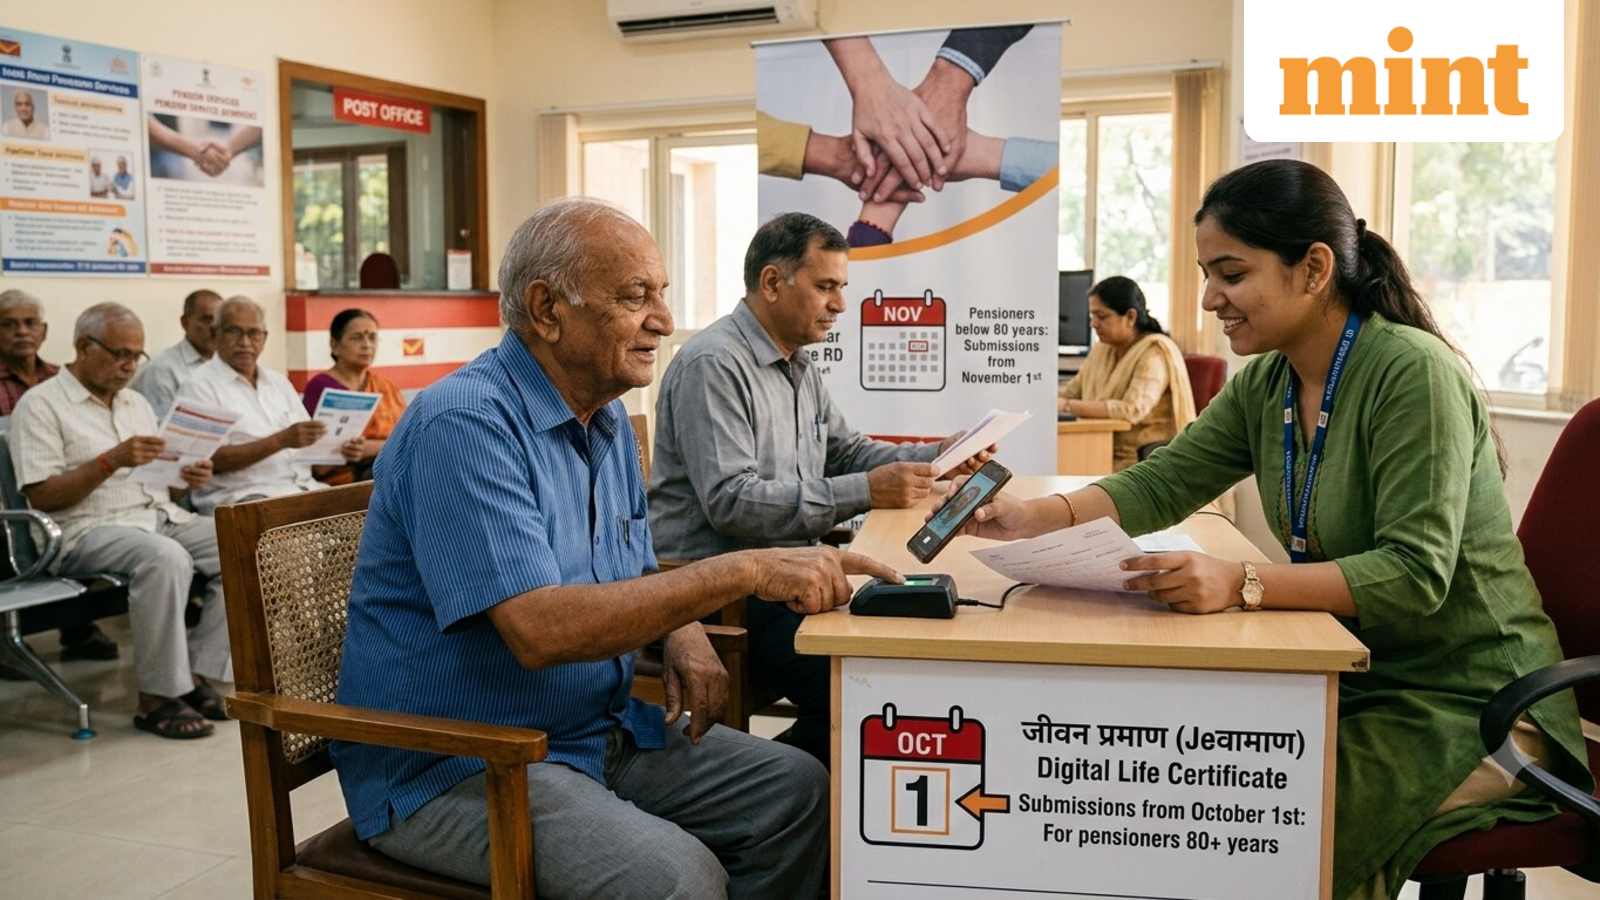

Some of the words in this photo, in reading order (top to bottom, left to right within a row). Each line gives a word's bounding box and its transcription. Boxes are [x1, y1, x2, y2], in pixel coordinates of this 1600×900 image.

[343, 97, 379, 119] POST
[380, 104, 424, 126] OFFICE
[883, 306, 923, 322] NOV
[969, 307, 1035, 320] Pensioners
[955, 323, 990, 336] below
[993, 324, 1009, 336] 80
[1012, 326, 1049, 340] years:
[823, 347, 843, 362] RD
[964, 339, 1040, 352] Submissions
[987, 355, 1015, 367] from
[961, 371, 1022, 384] November
[1026, 372, 1042, 384] 1st
[1020, 713, 1092, 746] जीवन
[1096, 724, 1170, 749] प्रमाण
[897, 731, 947, 756] OCT
[1037, 756, 1110, 785] Digital
[1118, 759, 1160, 784] Life
[1167, 761, 1288, 790] Certificate
[905, 775, 928, 827] 1
[1018, 793, 1136, 818] Submissions
[1141, 799, 1185, 820] from
[1191, 801, 1266, 824] October
[1271, 805, 1306, 826] 1st:
[1043, 823, 1074, 843] For
[1078, 827, 1181, 849] pensioners
[1186, 830, 1221, 851] 80+
[1227, 836, 1280, 856] years
